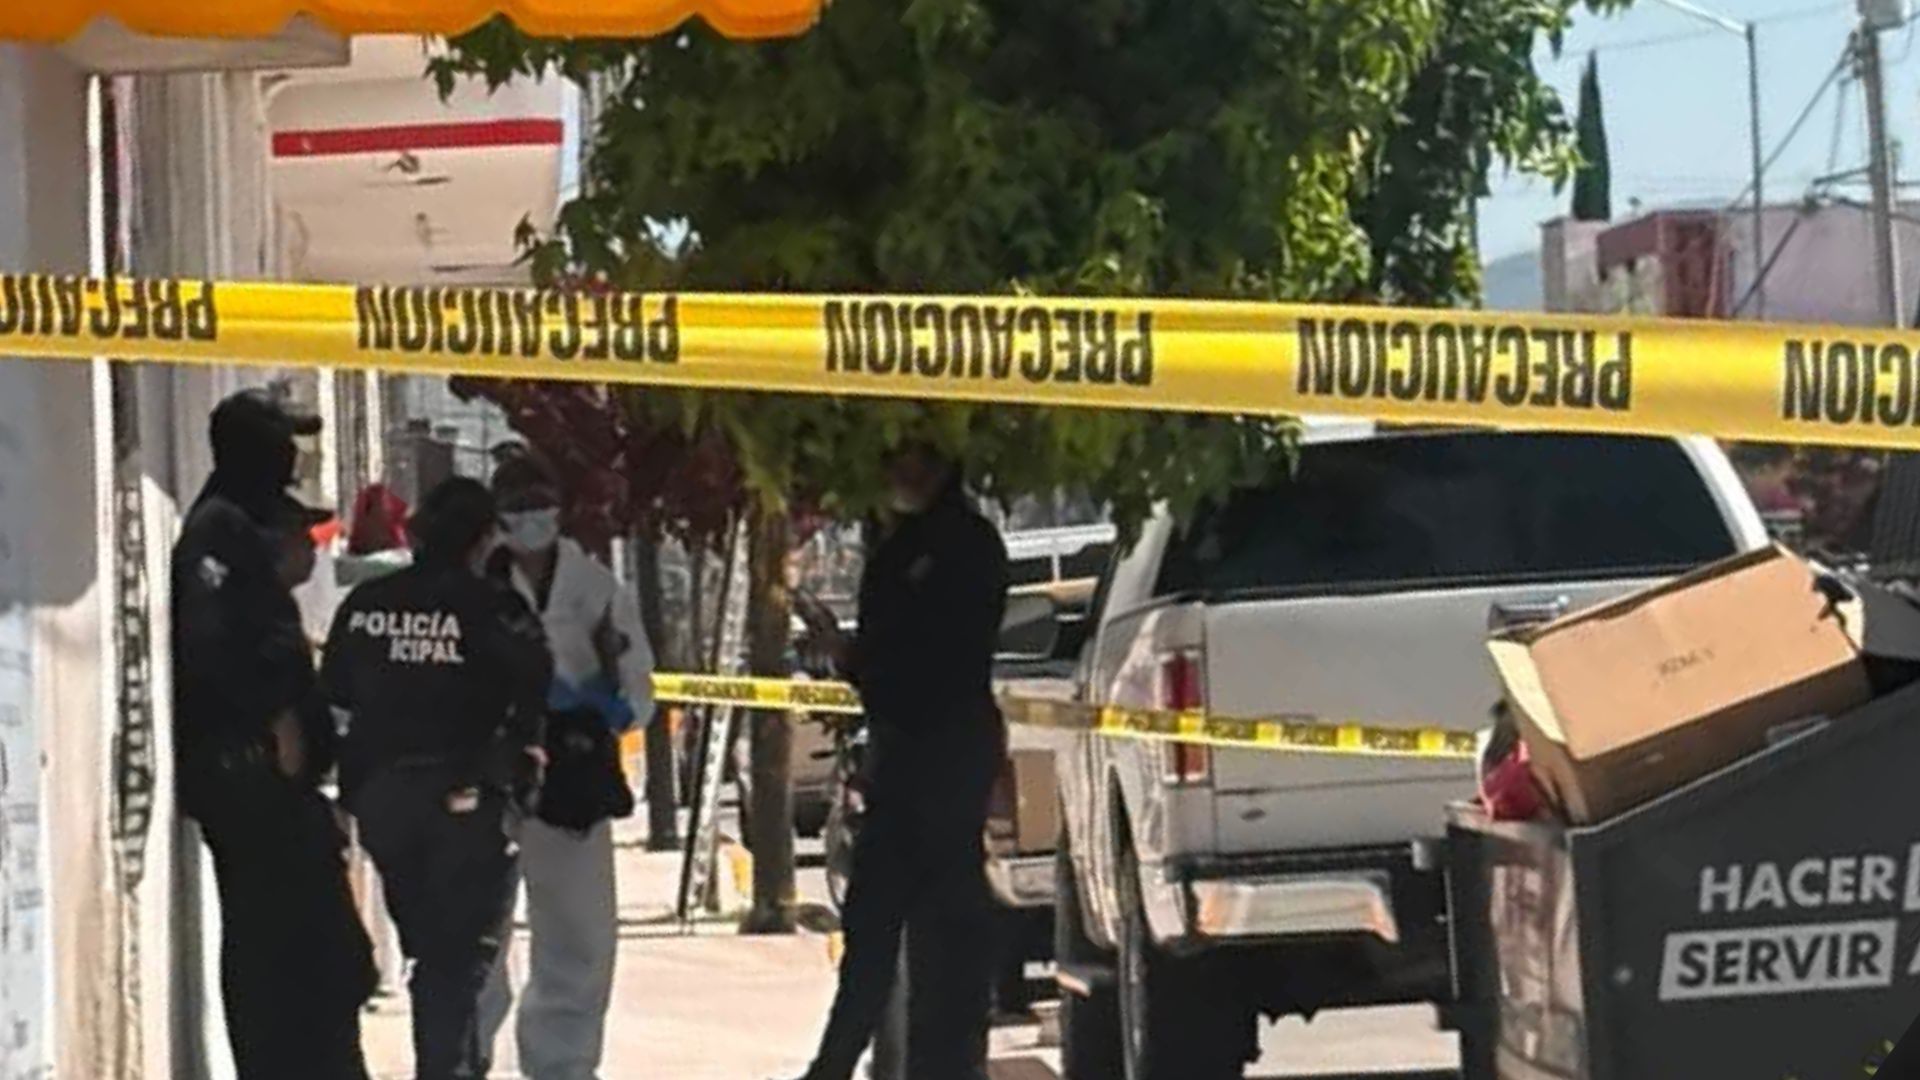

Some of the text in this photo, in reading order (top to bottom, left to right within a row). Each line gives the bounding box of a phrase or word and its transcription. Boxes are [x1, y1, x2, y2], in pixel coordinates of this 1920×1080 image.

[356, 284, 679, 364] PRECAUCION
[824, 300, 1154, 387] PRECAUCION
[1296, 318, 1633, 410] PRECAUCION
[1783, 339, 1920, 426] CION
[1699, 854, 1897, 913] HACER
[1676, 931, 1882, 989] SERVIR
